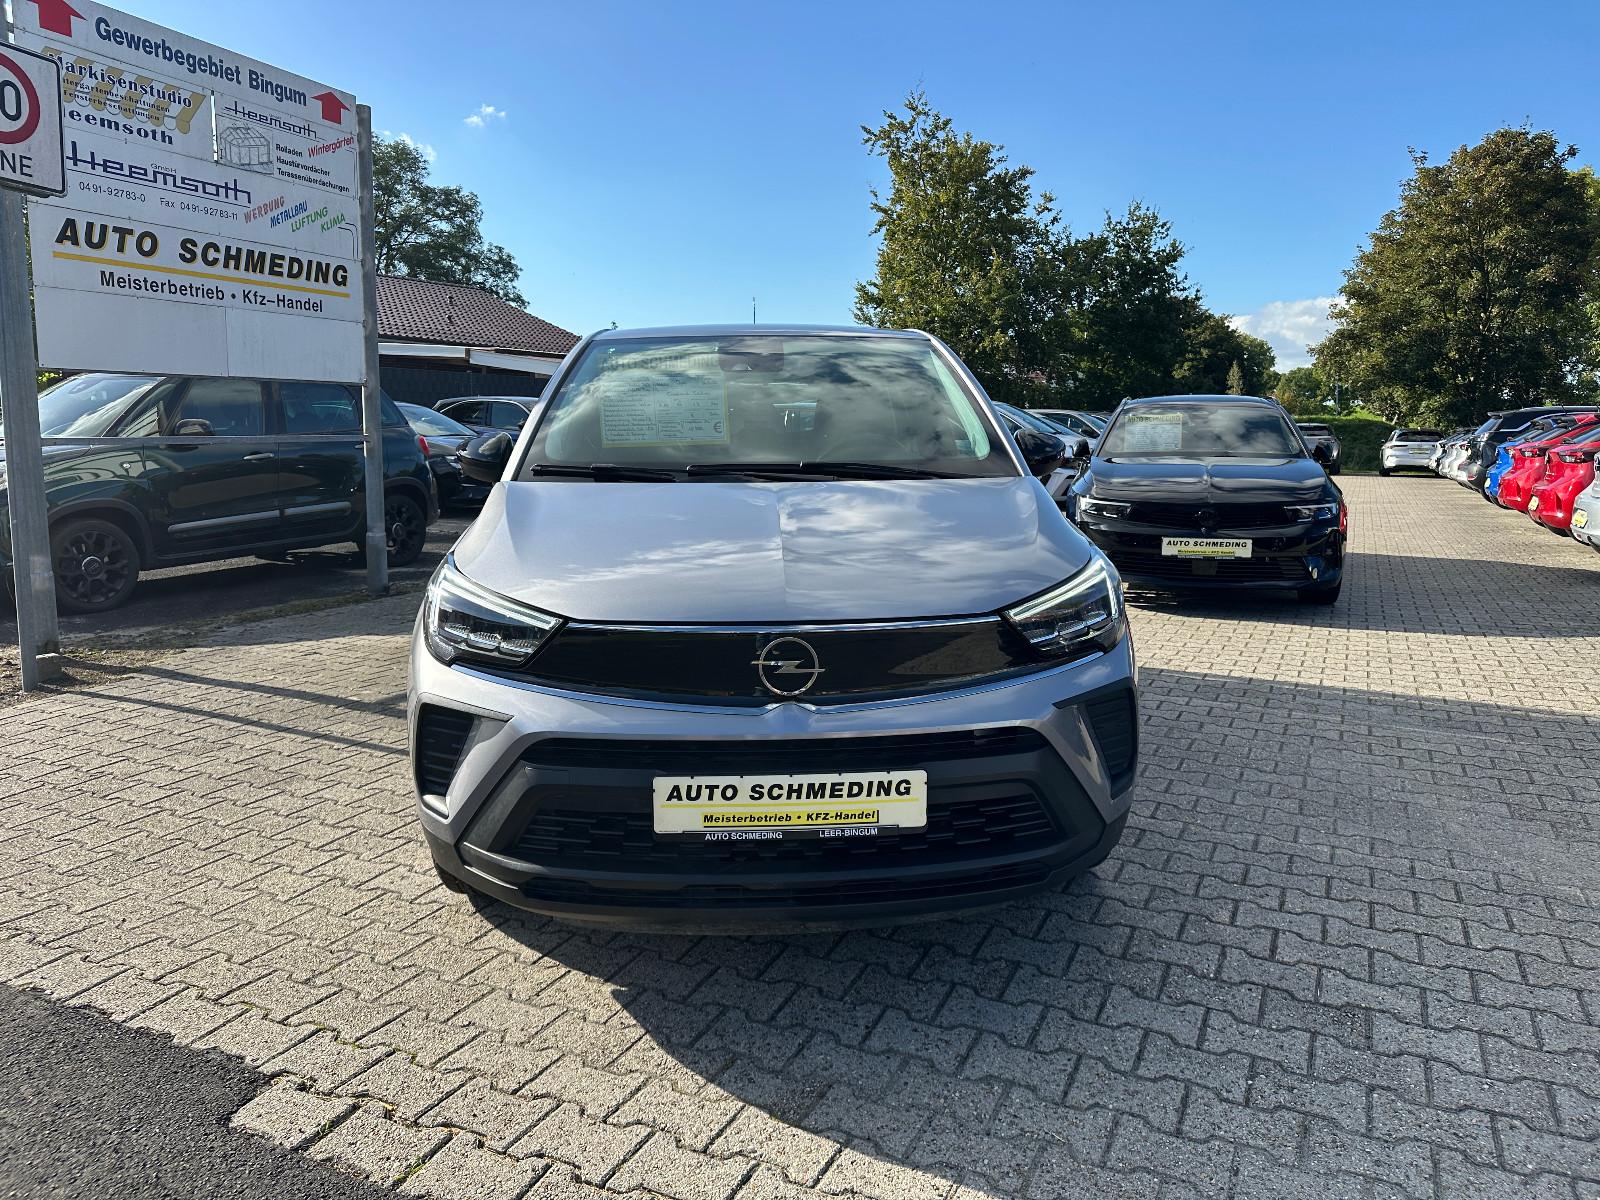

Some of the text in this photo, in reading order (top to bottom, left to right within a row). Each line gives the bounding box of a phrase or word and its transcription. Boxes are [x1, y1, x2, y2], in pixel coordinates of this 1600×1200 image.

[94, 16, 307, 107] Gewerbegebiet Bingum
[63, 106, 174, 146] eemsoth
[275, 143, 303, 158] Rolladen
[307, 135, 355, 158] Wintergärten
[66, 141, 252, 204] Heemsoth
[79, 181, 239, 221] 0491-92783-0 Fax 0491-92783-11
[243, 195, 285, 224] WERBUNG
[270, 200, 308, 229] METALLBAU
[320, 212, 346, 233] KLIMA
[55, 217, 349, 288] AUTO SCHMEDING
[99, 270, 323, 313] Meisterbetrieb Kfz-Handel
[1193, 540, 1247, 548] SCHMEDING
[666, 779, 912, 802] AUTO SCHMEDING
[703, 810, 876, 824] Meisterbetrieb KFZ-Handel
[705, 827, 878, 841] AUTO SCHMEDING LEER-BINGUM
